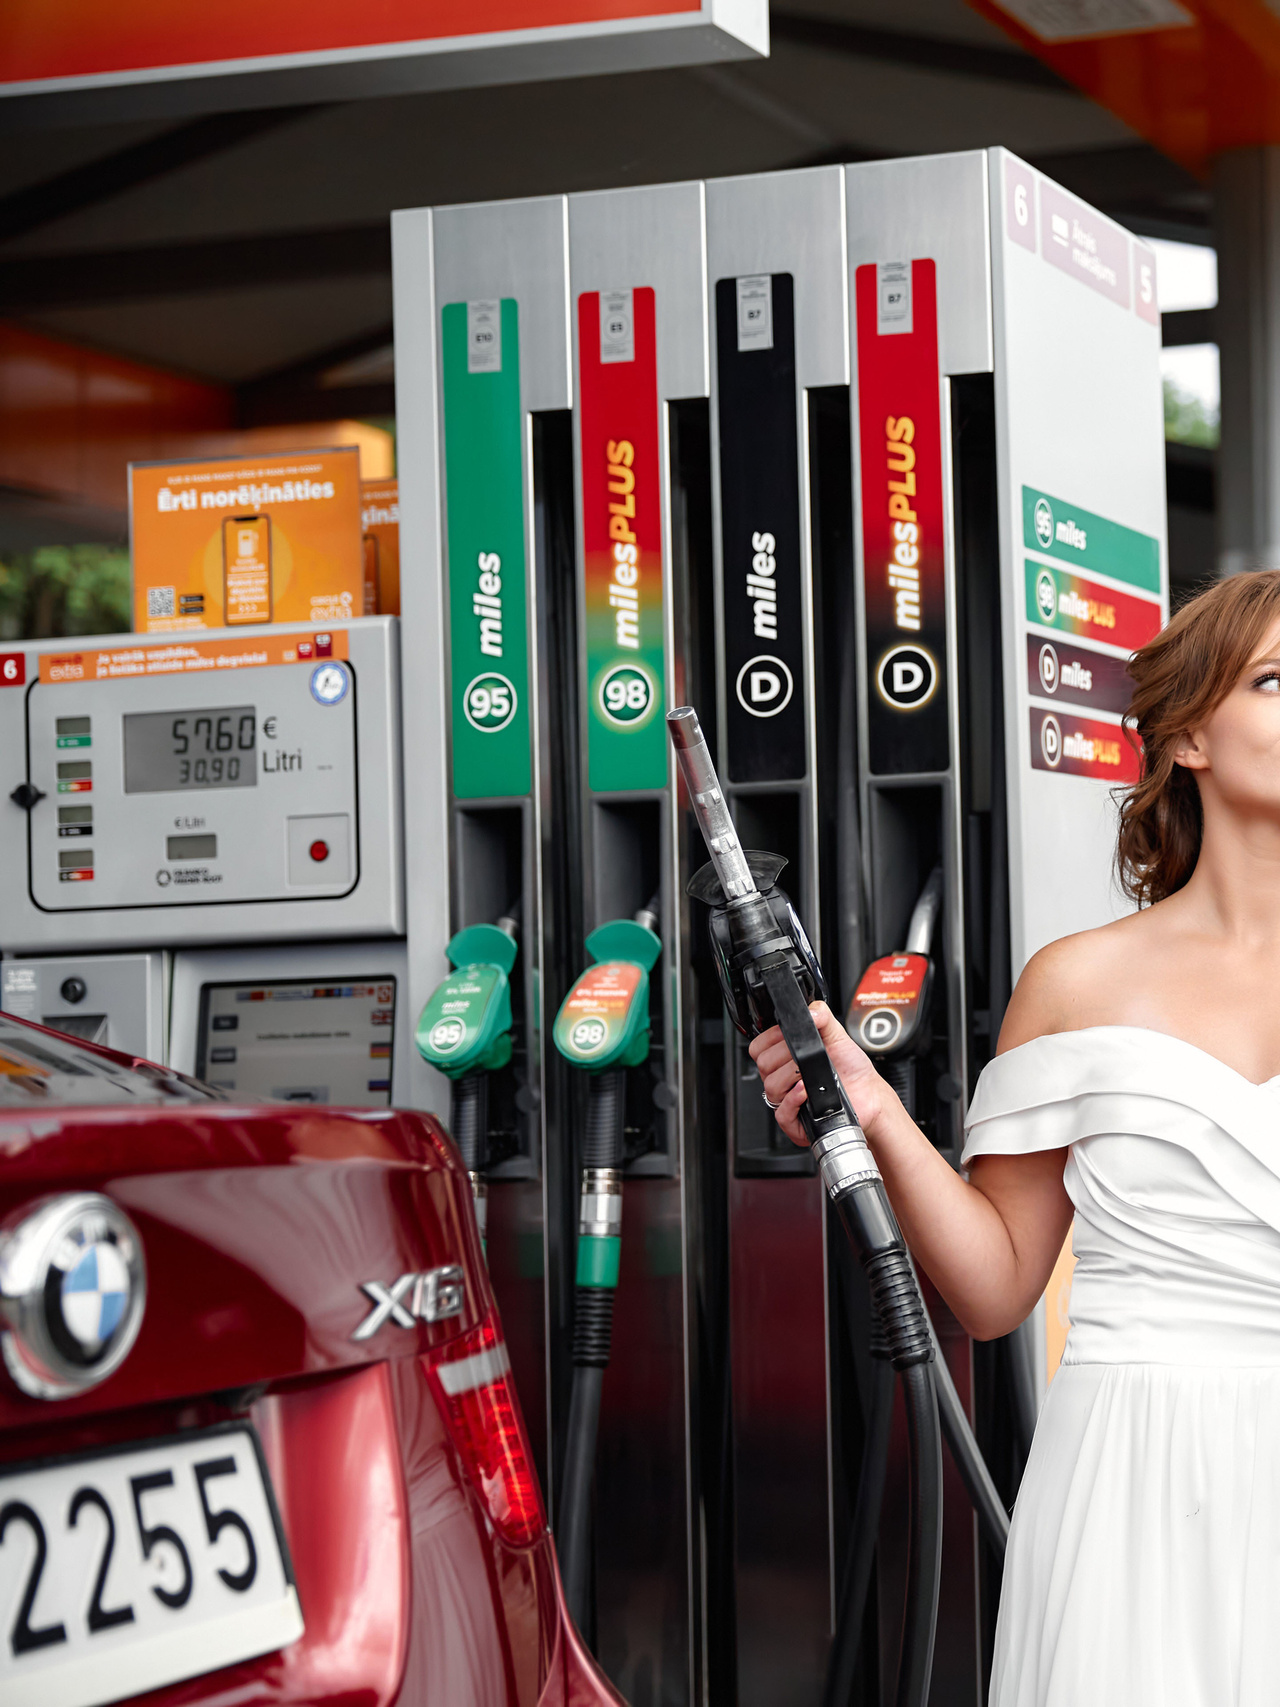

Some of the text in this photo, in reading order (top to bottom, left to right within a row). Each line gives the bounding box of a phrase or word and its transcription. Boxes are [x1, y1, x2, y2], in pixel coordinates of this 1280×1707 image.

[1014, 183, 1029, 227] 6
[1140, 263, 1153, 304] 5
[157, 479, 335, 513] Ērti norēķināties
[886, 415, 921, 631] milesPLUS
[1036, 509, 1051, 537] 95
[1055, 519, 1087, 551] miles
[606, 439, 640, 650] milesPLUS
[747, 531, 778, 640] miles
[473, 552, 502, 657] miles
[1058, 589, 1116, 630] milesPLUS
[3, 659, 17, 679] 6
[893, 661, 924, 693] D
[1042, 655, 1056, 681] D
[1060, 660, 1093, 692] miles
[469, 686, 511, 720] 95
[605, 678, 648, 712] 98
[750, 671, 781, 703] D
[263, 716, 277, 739] €
[1046, 728, 1058, 755] D
[263, 749, 302, 773] Litri
[1063, 730, 1121, 766] milesPLUS
[434, 1024, 460, 1046] 95
[575, 1024, 603, 1045] 98
[869, 1017, 892, 1039] D
